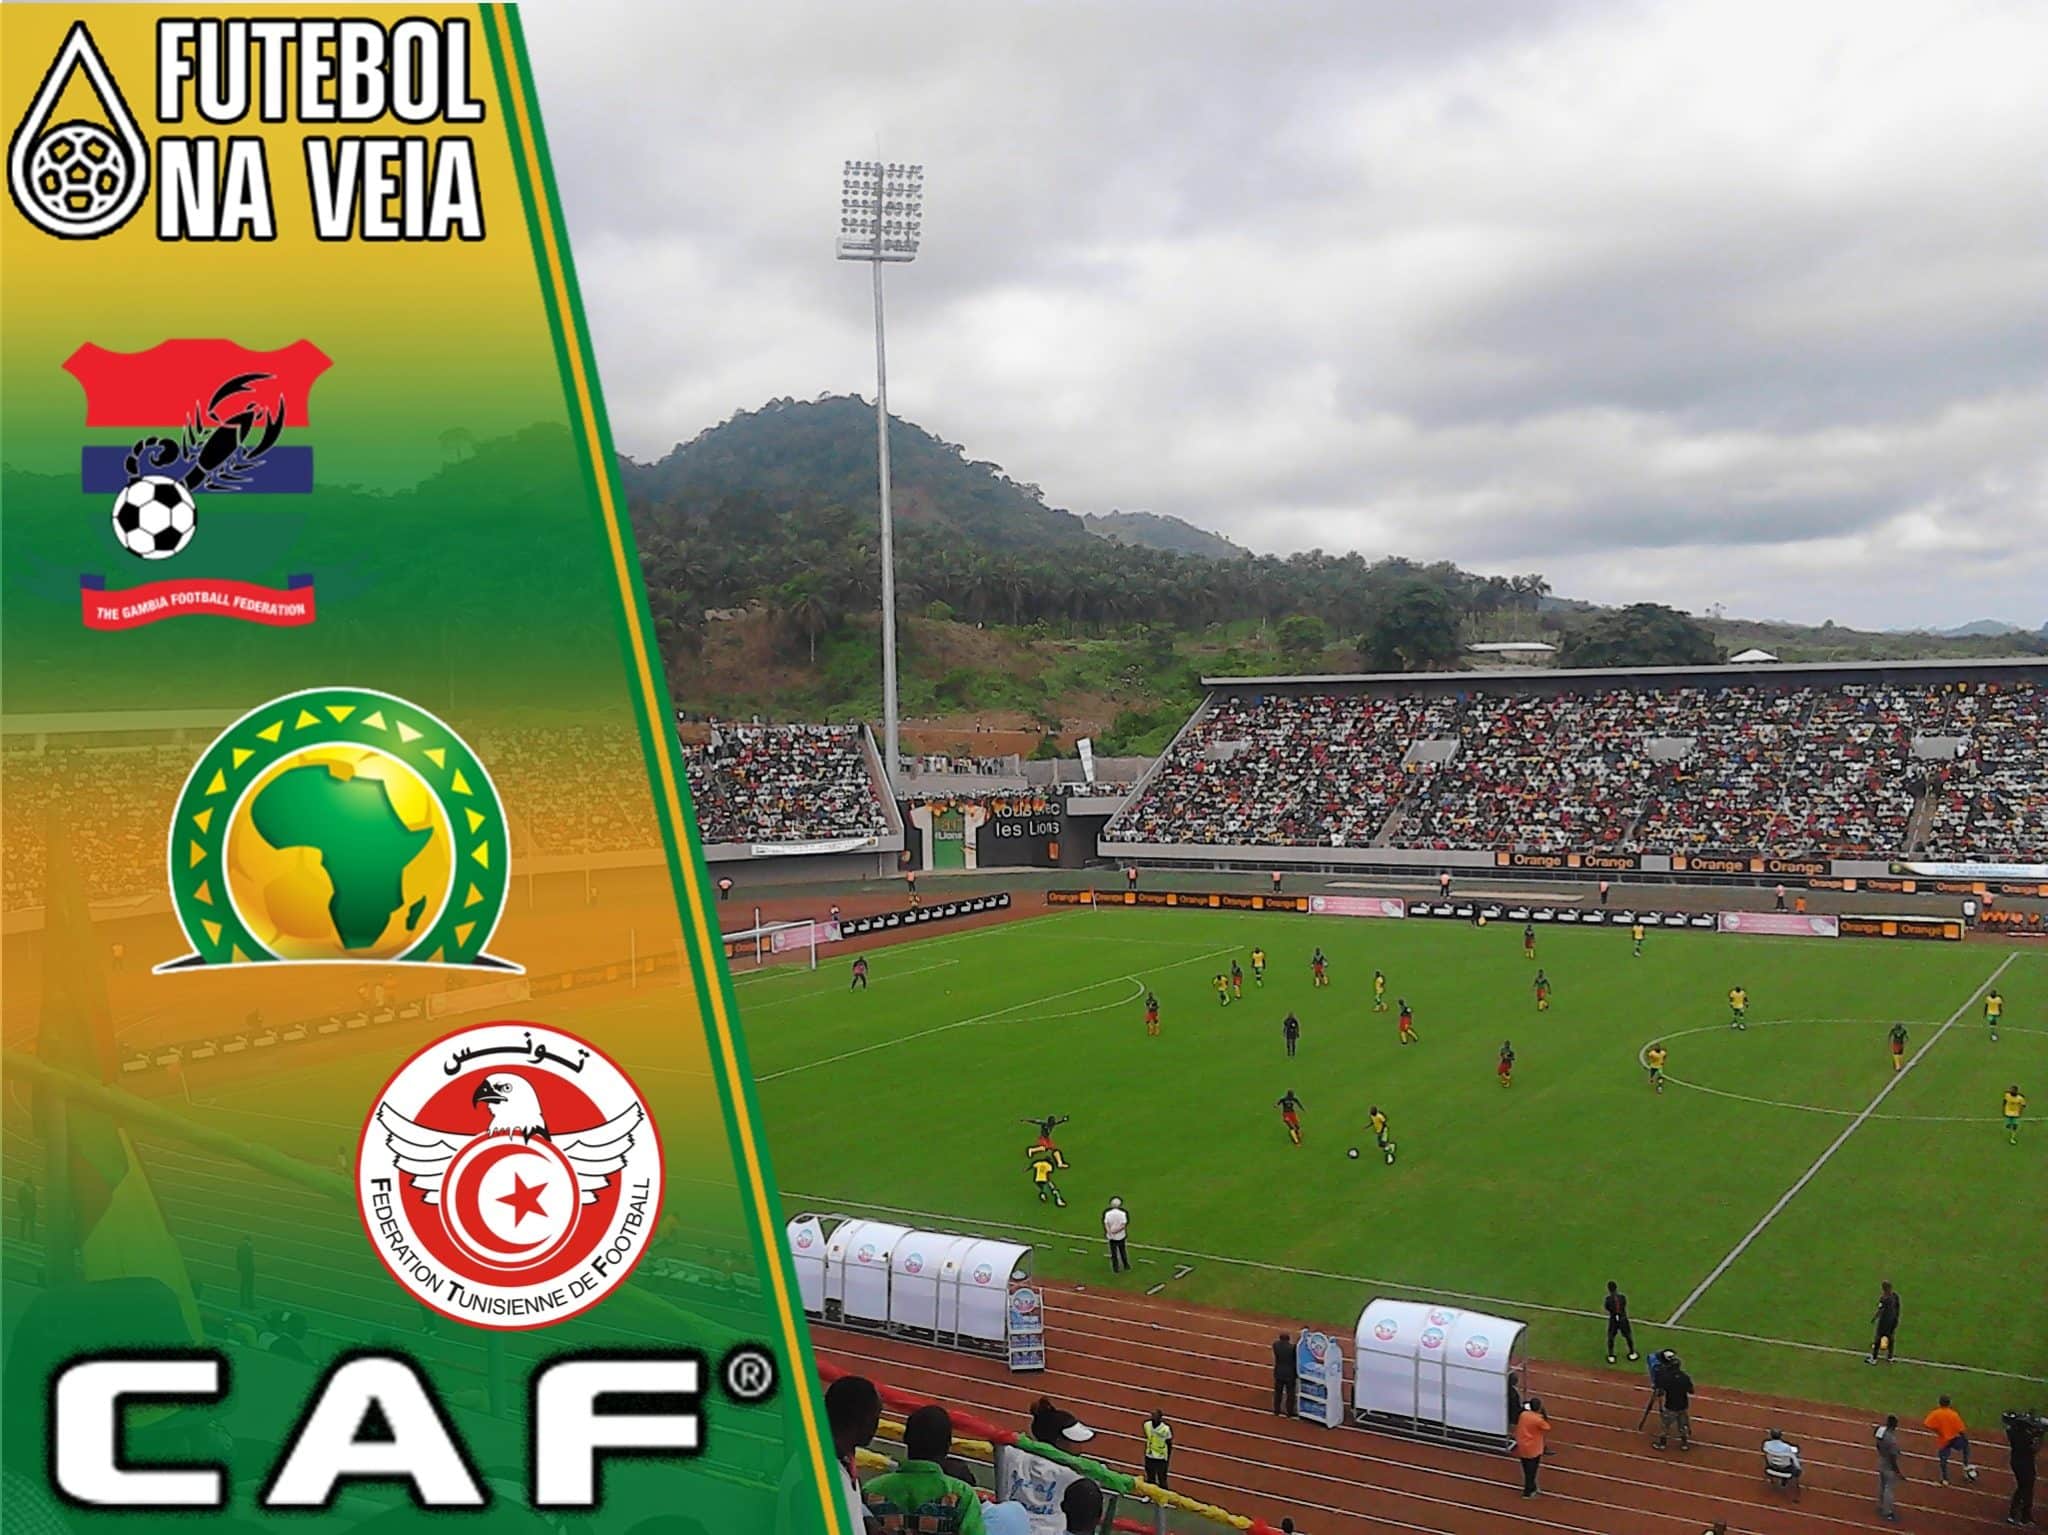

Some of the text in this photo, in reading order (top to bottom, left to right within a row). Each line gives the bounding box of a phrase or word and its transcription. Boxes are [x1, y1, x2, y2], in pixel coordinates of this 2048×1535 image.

[996, 820, 1060, 837] les Lions
[1515, 854, 1634, 868] Orange Orange
[1691, 858, 1824, 874] Orange Orange
[1050, 893, 1080, 904] Orange
[1840, 922, 1943, 937] Orange Orange
